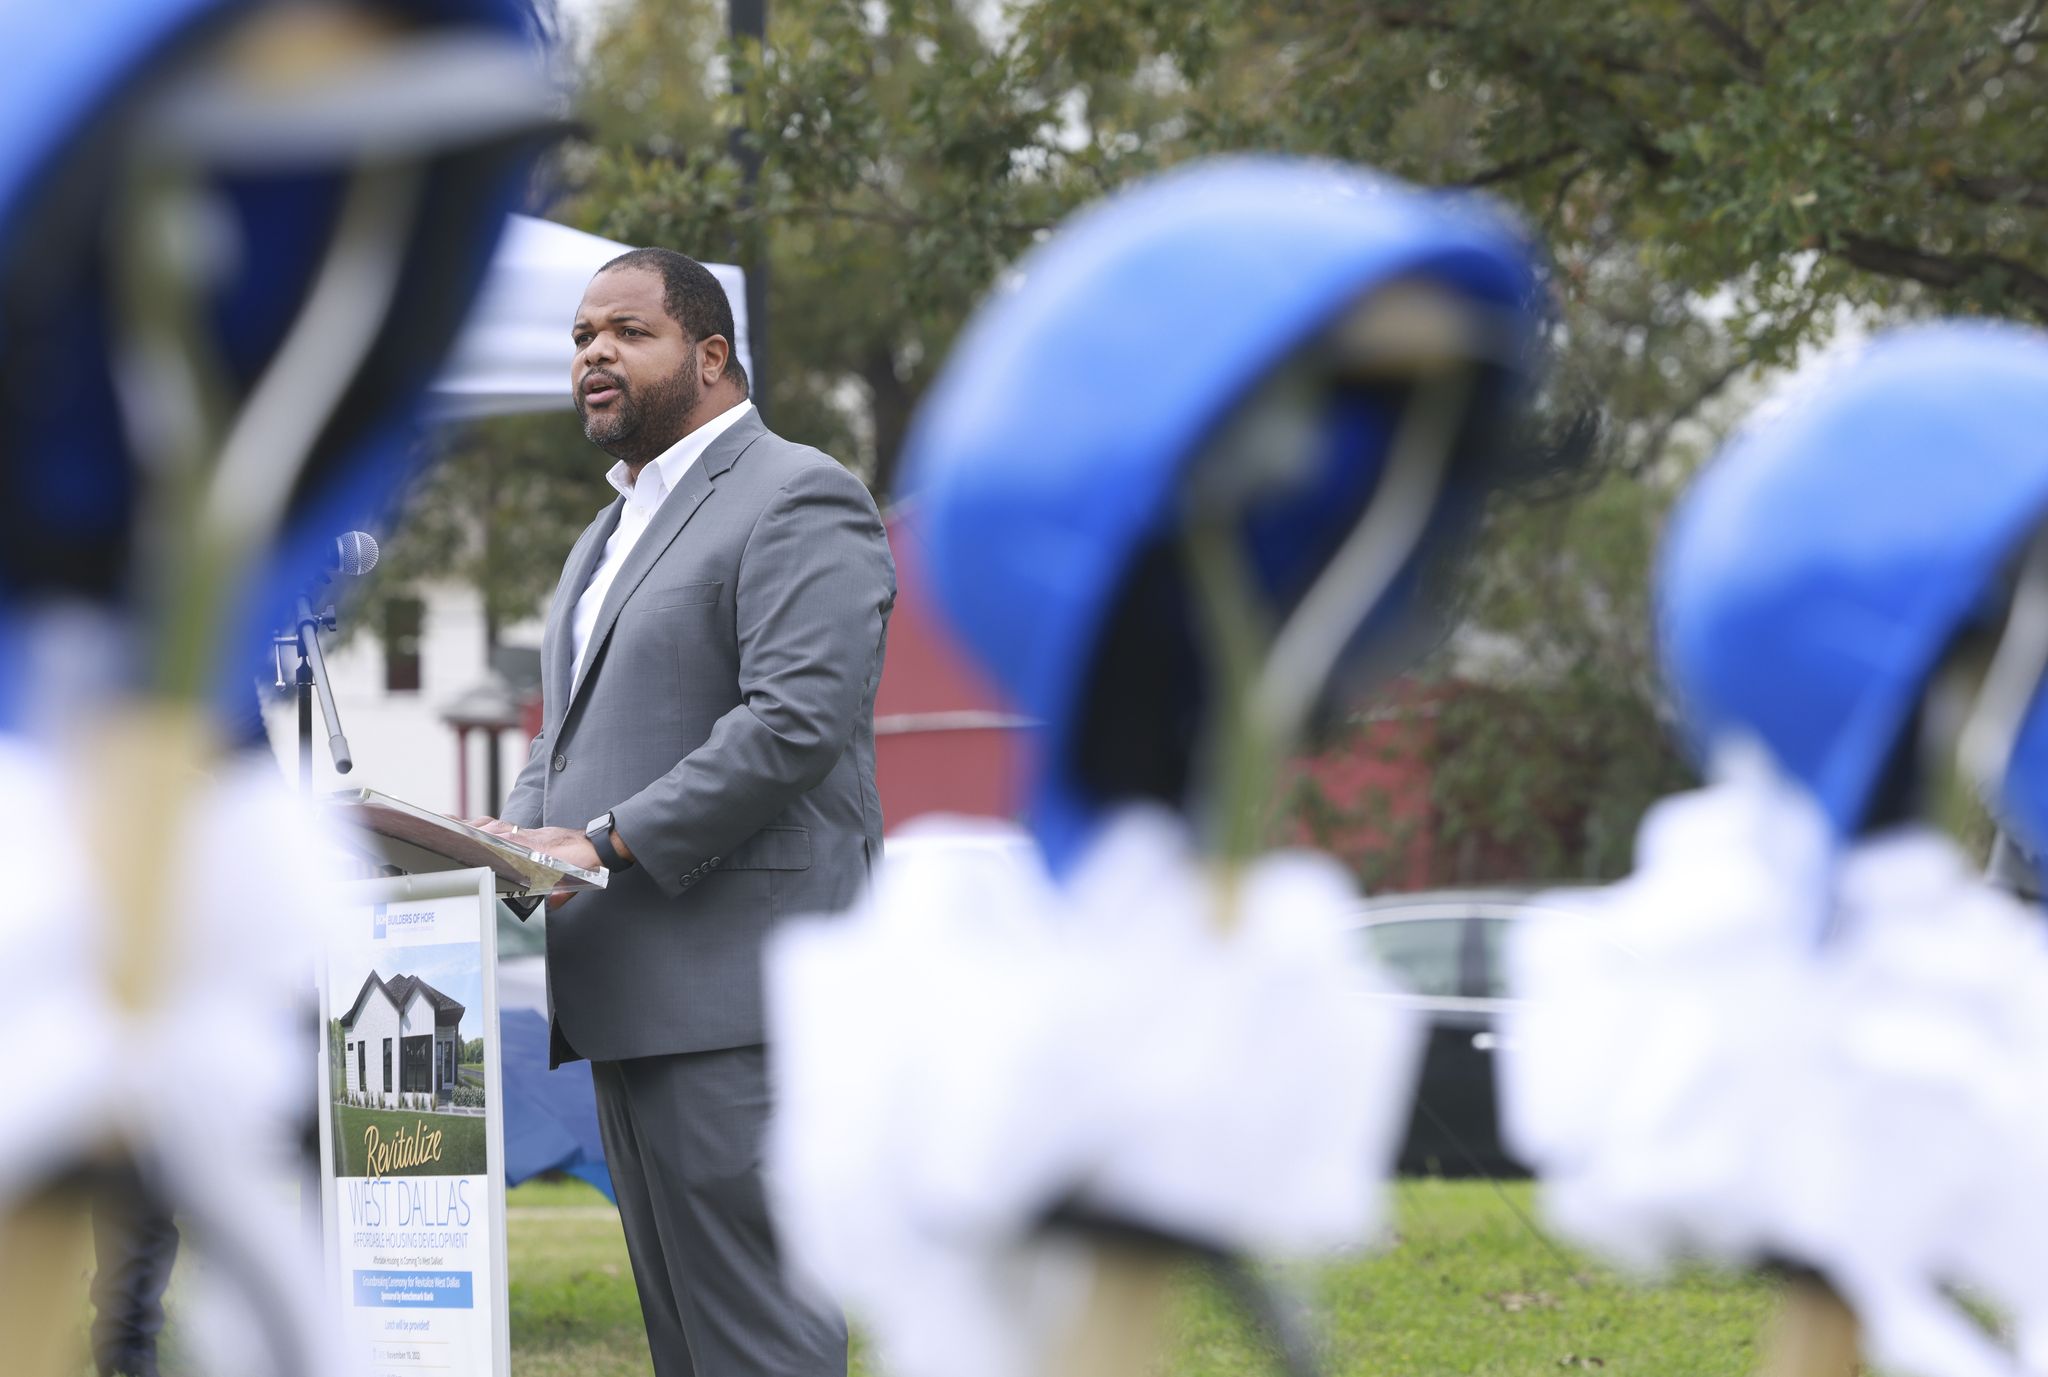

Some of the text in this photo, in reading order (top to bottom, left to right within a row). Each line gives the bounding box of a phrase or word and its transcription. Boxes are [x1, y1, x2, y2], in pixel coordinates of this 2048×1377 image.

[388, 911, 435, 925] BUILDERS OF HOPE
[364, 1119, 443, 1184] Revitalize
[348, 1179, 471, 1227] WEST DALLAS
[353, 1232, 468, 1248] AFFORDABLE HOUSING DEVELOPMENT
[407, 1275, 415, 1288] for
[435, 1277, 446, 1288] West
[446, 1276, 460, 1288] Dallas
